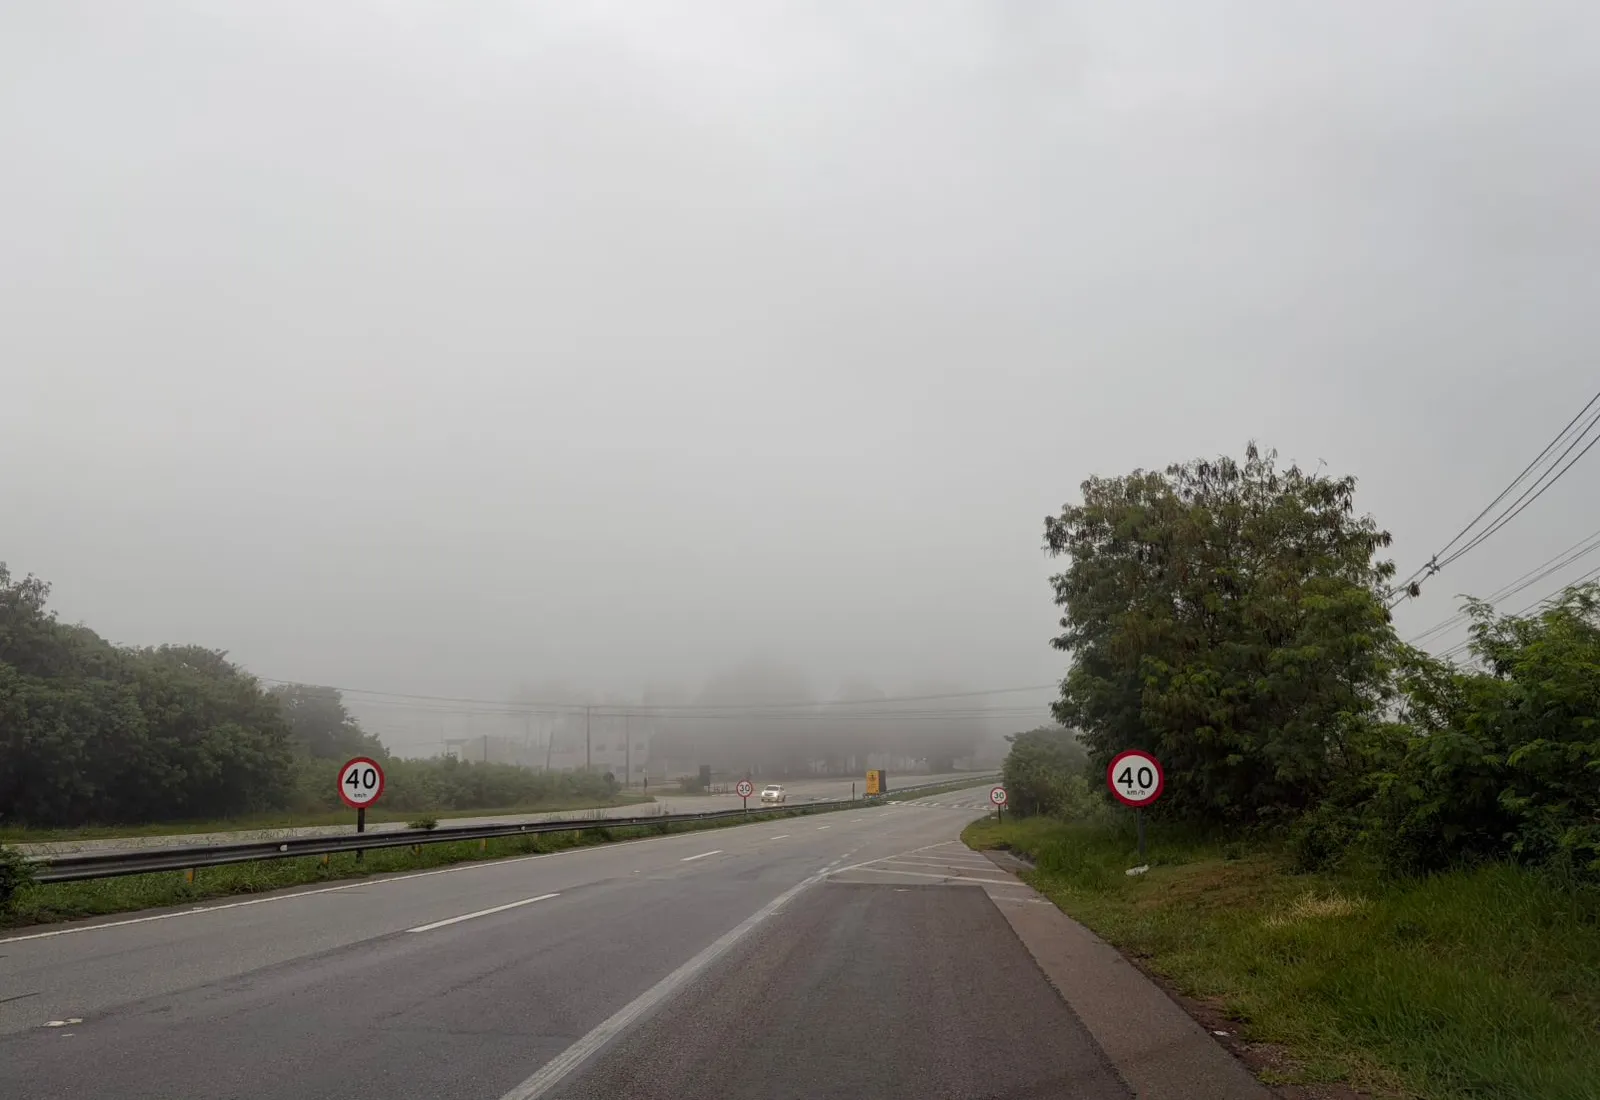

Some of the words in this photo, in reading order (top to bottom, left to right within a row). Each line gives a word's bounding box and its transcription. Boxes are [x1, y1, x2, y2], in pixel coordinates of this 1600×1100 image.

[345, 768, 376, 789] 40
[1117, 766, 1153, 789] 40
[740, 784, 750, 792] 30
[994, 791, 1004, 799] 30
